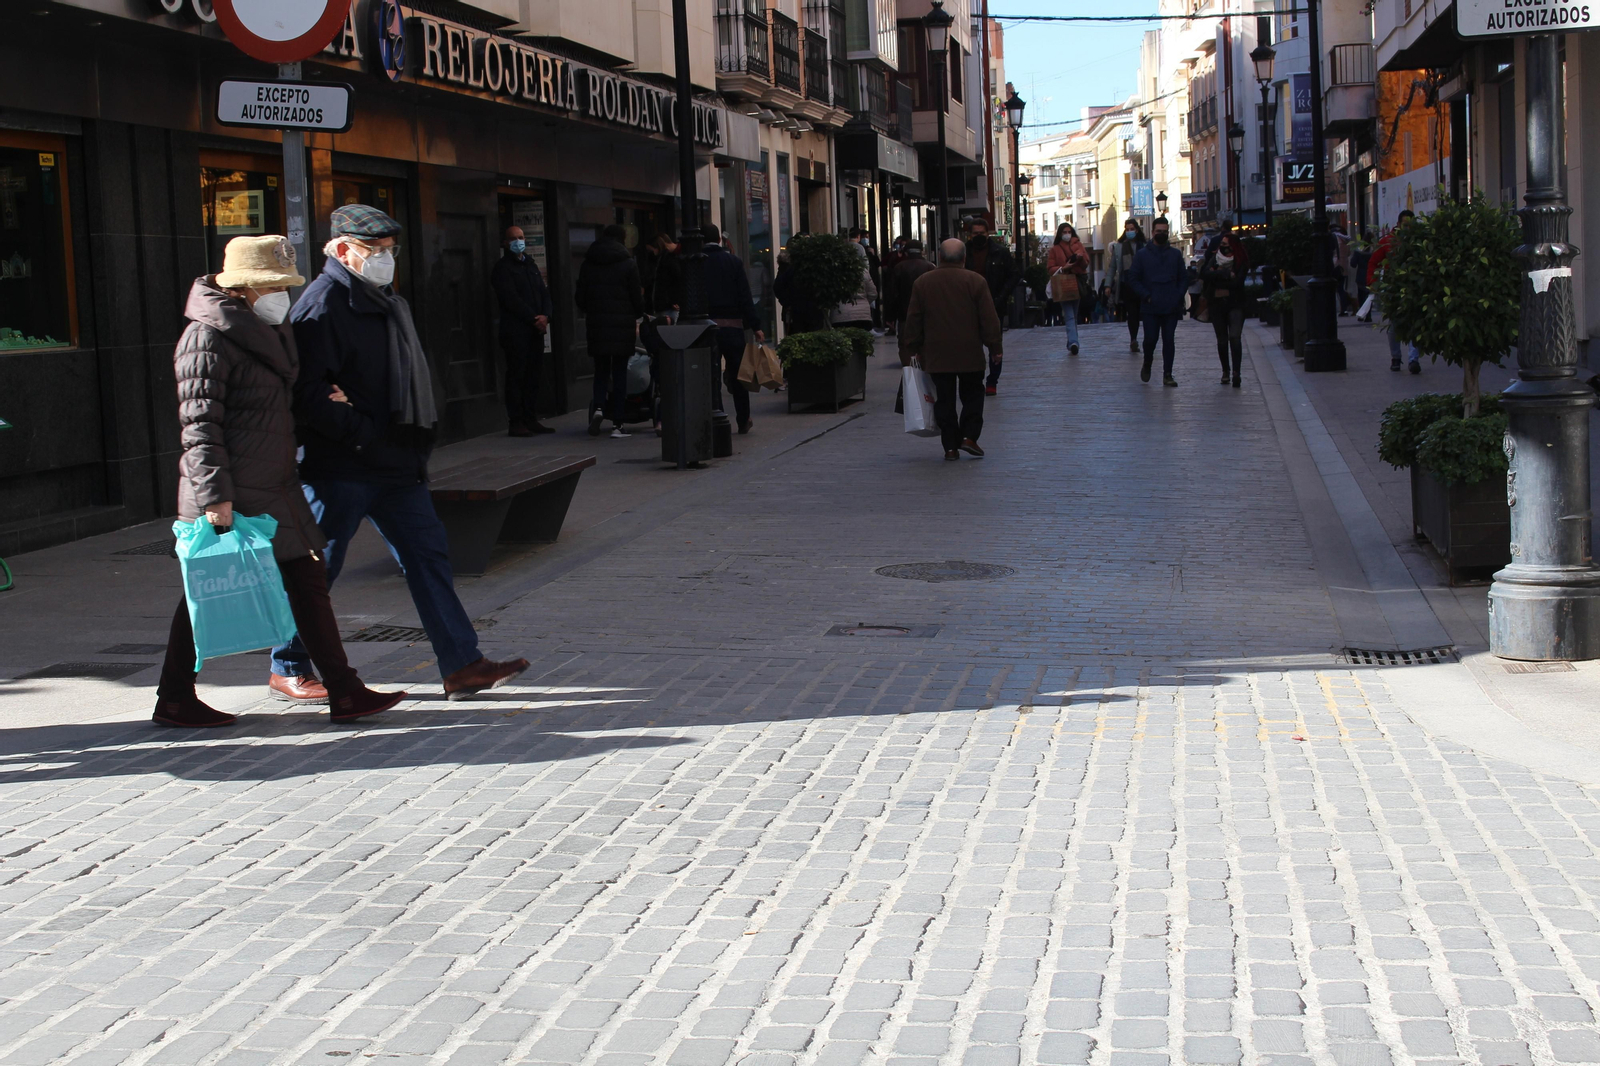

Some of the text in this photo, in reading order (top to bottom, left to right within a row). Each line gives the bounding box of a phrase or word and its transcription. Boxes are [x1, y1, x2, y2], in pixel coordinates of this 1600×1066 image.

[1487, 6, 1590, 30] AUTORIZADOS
[420, 18, 578, 111] RELOJERIA
[587, 70, 665, 133] ROLDAN
[670, 96, 724, 147] TICA
[257, 87, 309, 104] EXCEPTO
[1296, 89, 1312, 98] Z
[241, 104, 323, 123] AUTORIZADOS
